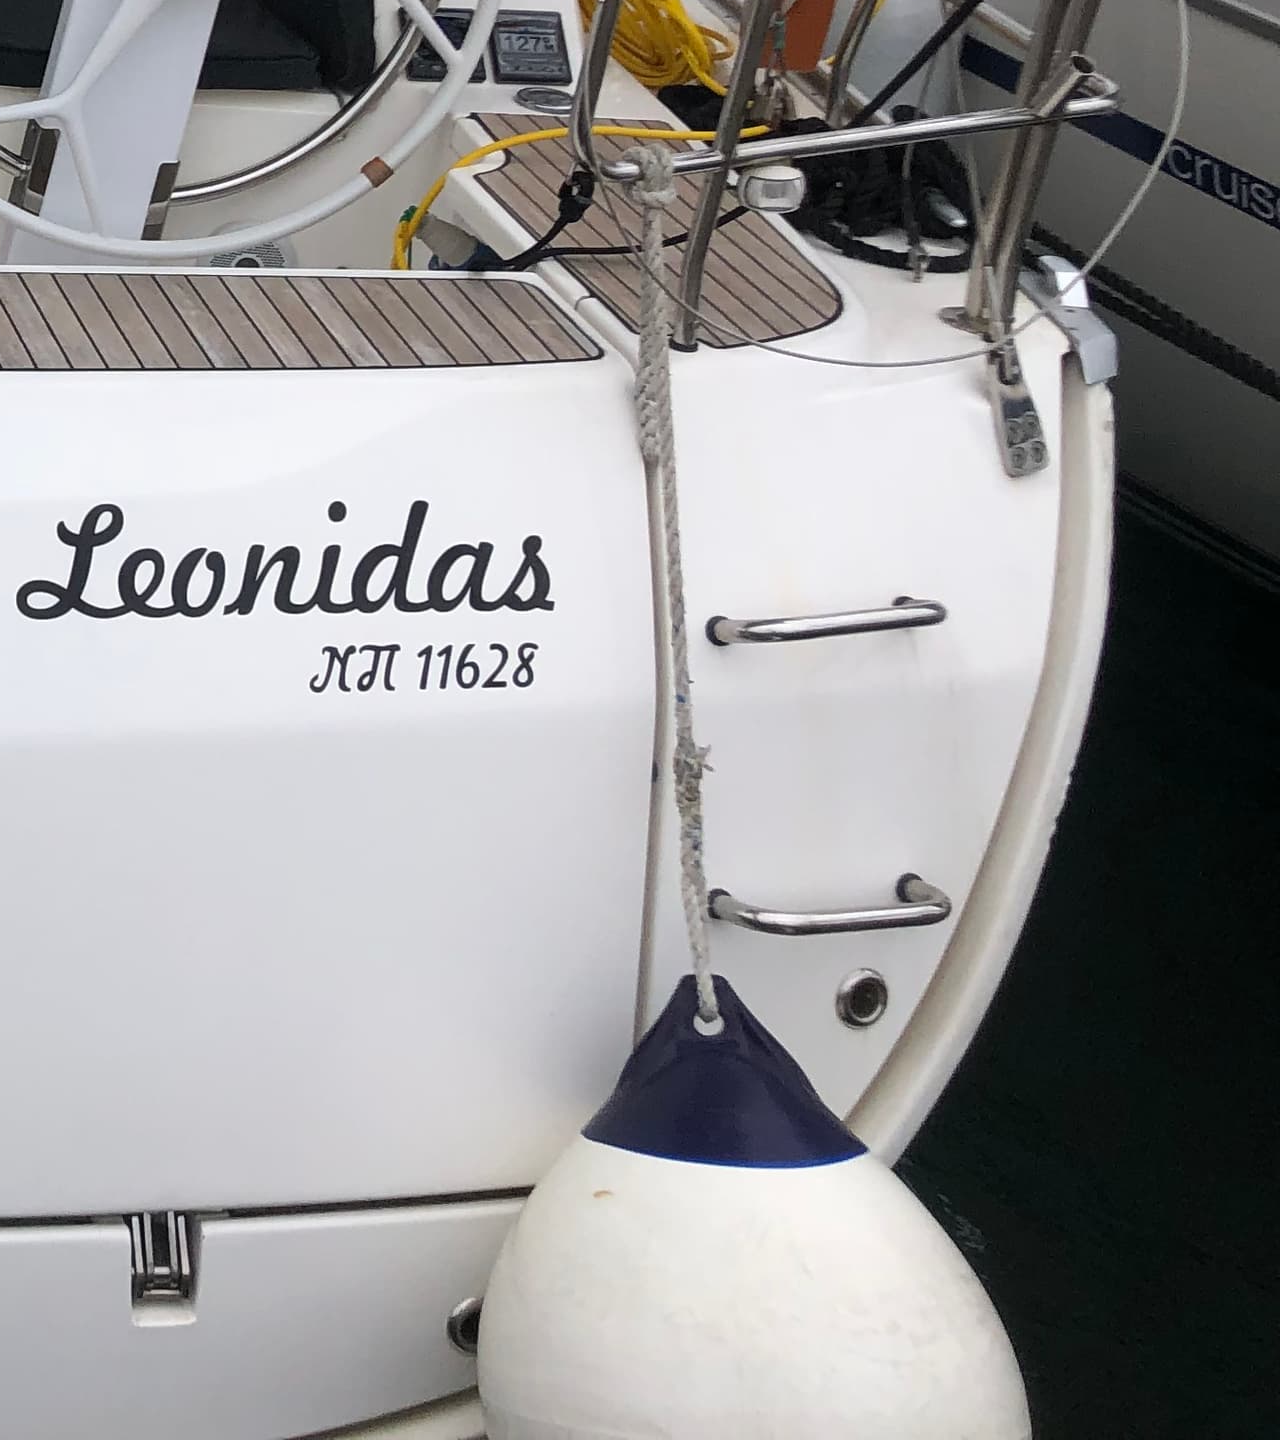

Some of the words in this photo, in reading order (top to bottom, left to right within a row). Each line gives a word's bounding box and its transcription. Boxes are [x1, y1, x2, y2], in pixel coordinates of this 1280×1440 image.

[1167, 145, 1280, 222] cruis
[16, 501, 554, 619] Leonidas
[418, 643, 538, 689] 11628
